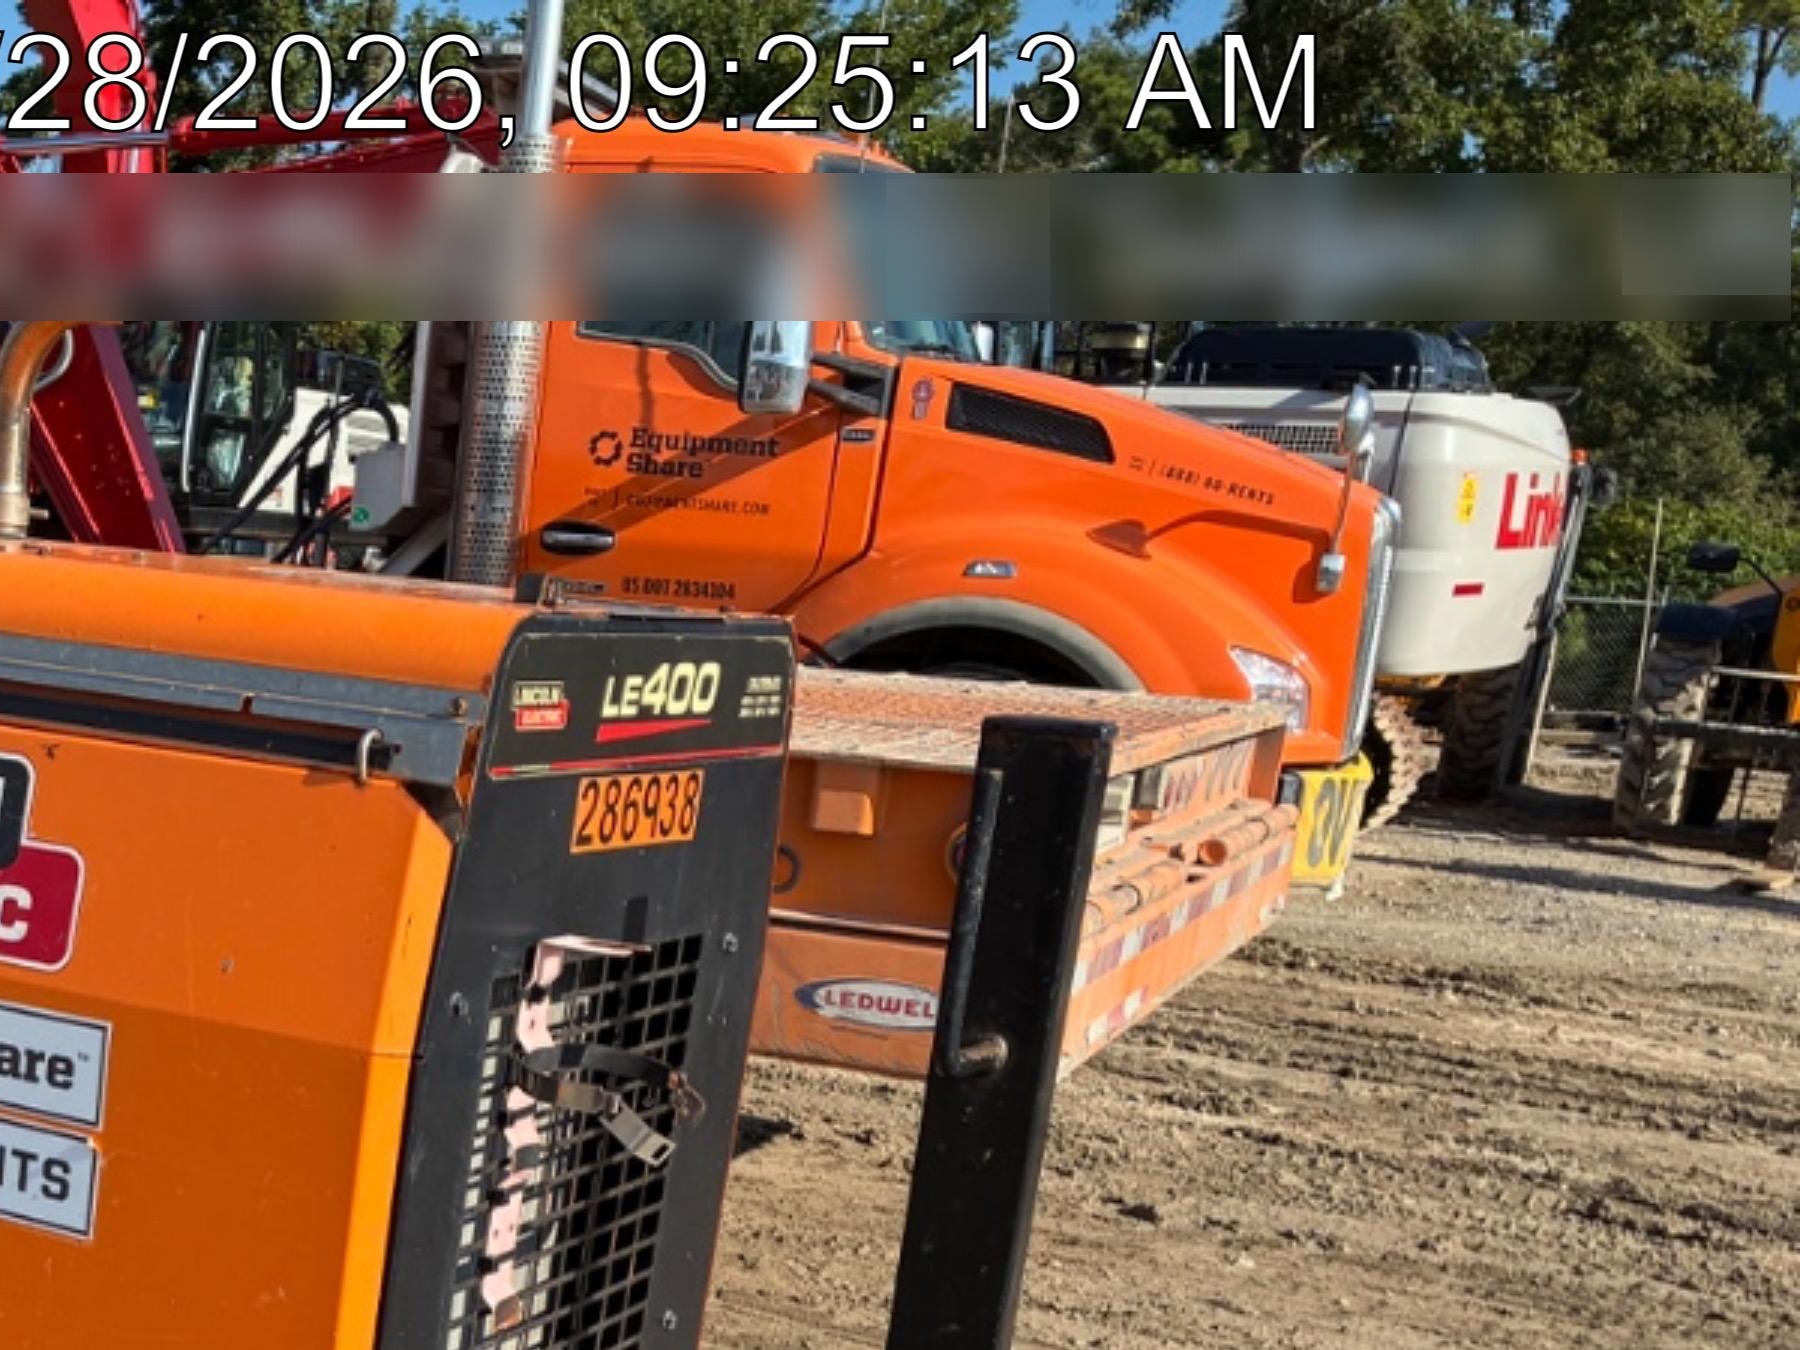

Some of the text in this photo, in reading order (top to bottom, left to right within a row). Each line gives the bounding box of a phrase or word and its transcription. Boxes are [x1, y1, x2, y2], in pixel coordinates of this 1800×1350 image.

[629, 428, 780, 458] Equipment
[626, 453, 704, 478] Share
[601, 662, 721, 718] LE400
[575, 773, 701, 847] 286938
[823, 989, 935, 1018] LEDWEL
